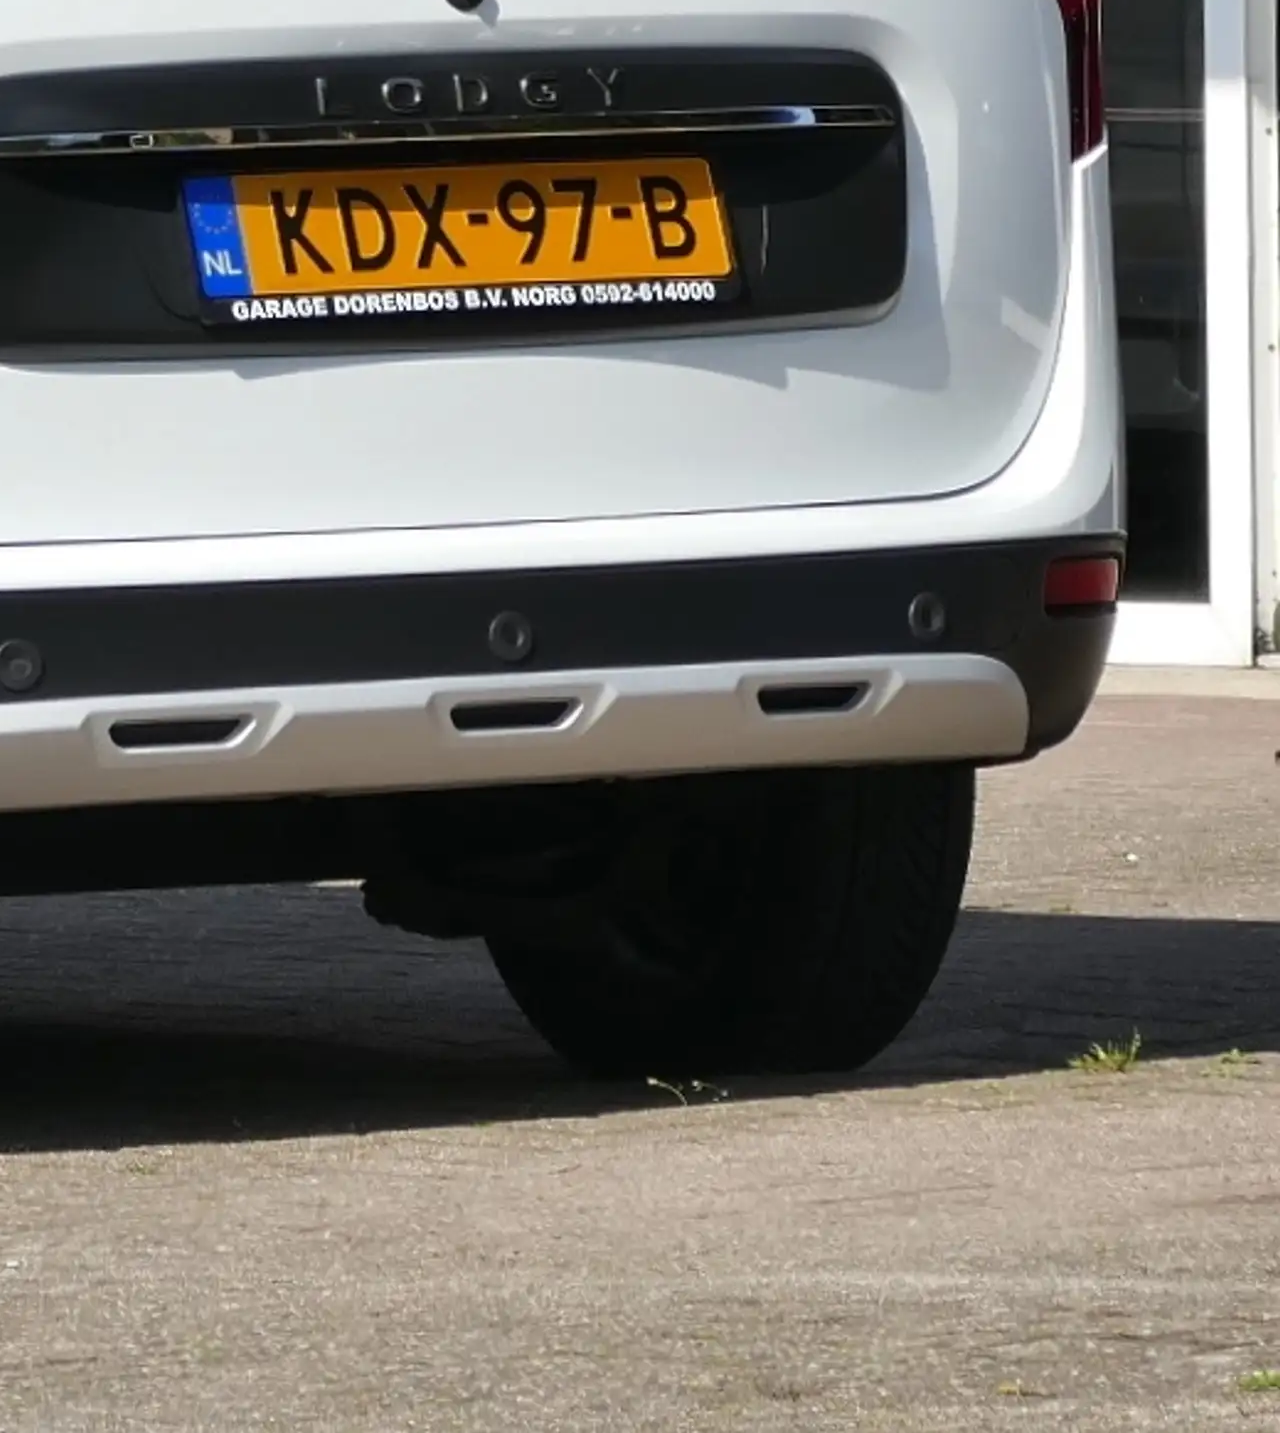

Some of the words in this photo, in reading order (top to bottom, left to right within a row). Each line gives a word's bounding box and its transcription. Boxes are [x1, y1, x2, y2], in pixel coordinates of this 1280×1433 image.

[315, 67, 625, 115] LODGY
[203, 249, 242, 277] NL
[269, 174, 697, 276] KDX-97-B
[231, 296, 328, 321] GARAGE
[333, 290, 459, 314] DORENBOS
[465, 288, 508, 310] B.V.
[512, 284, 577, 307] NORG
